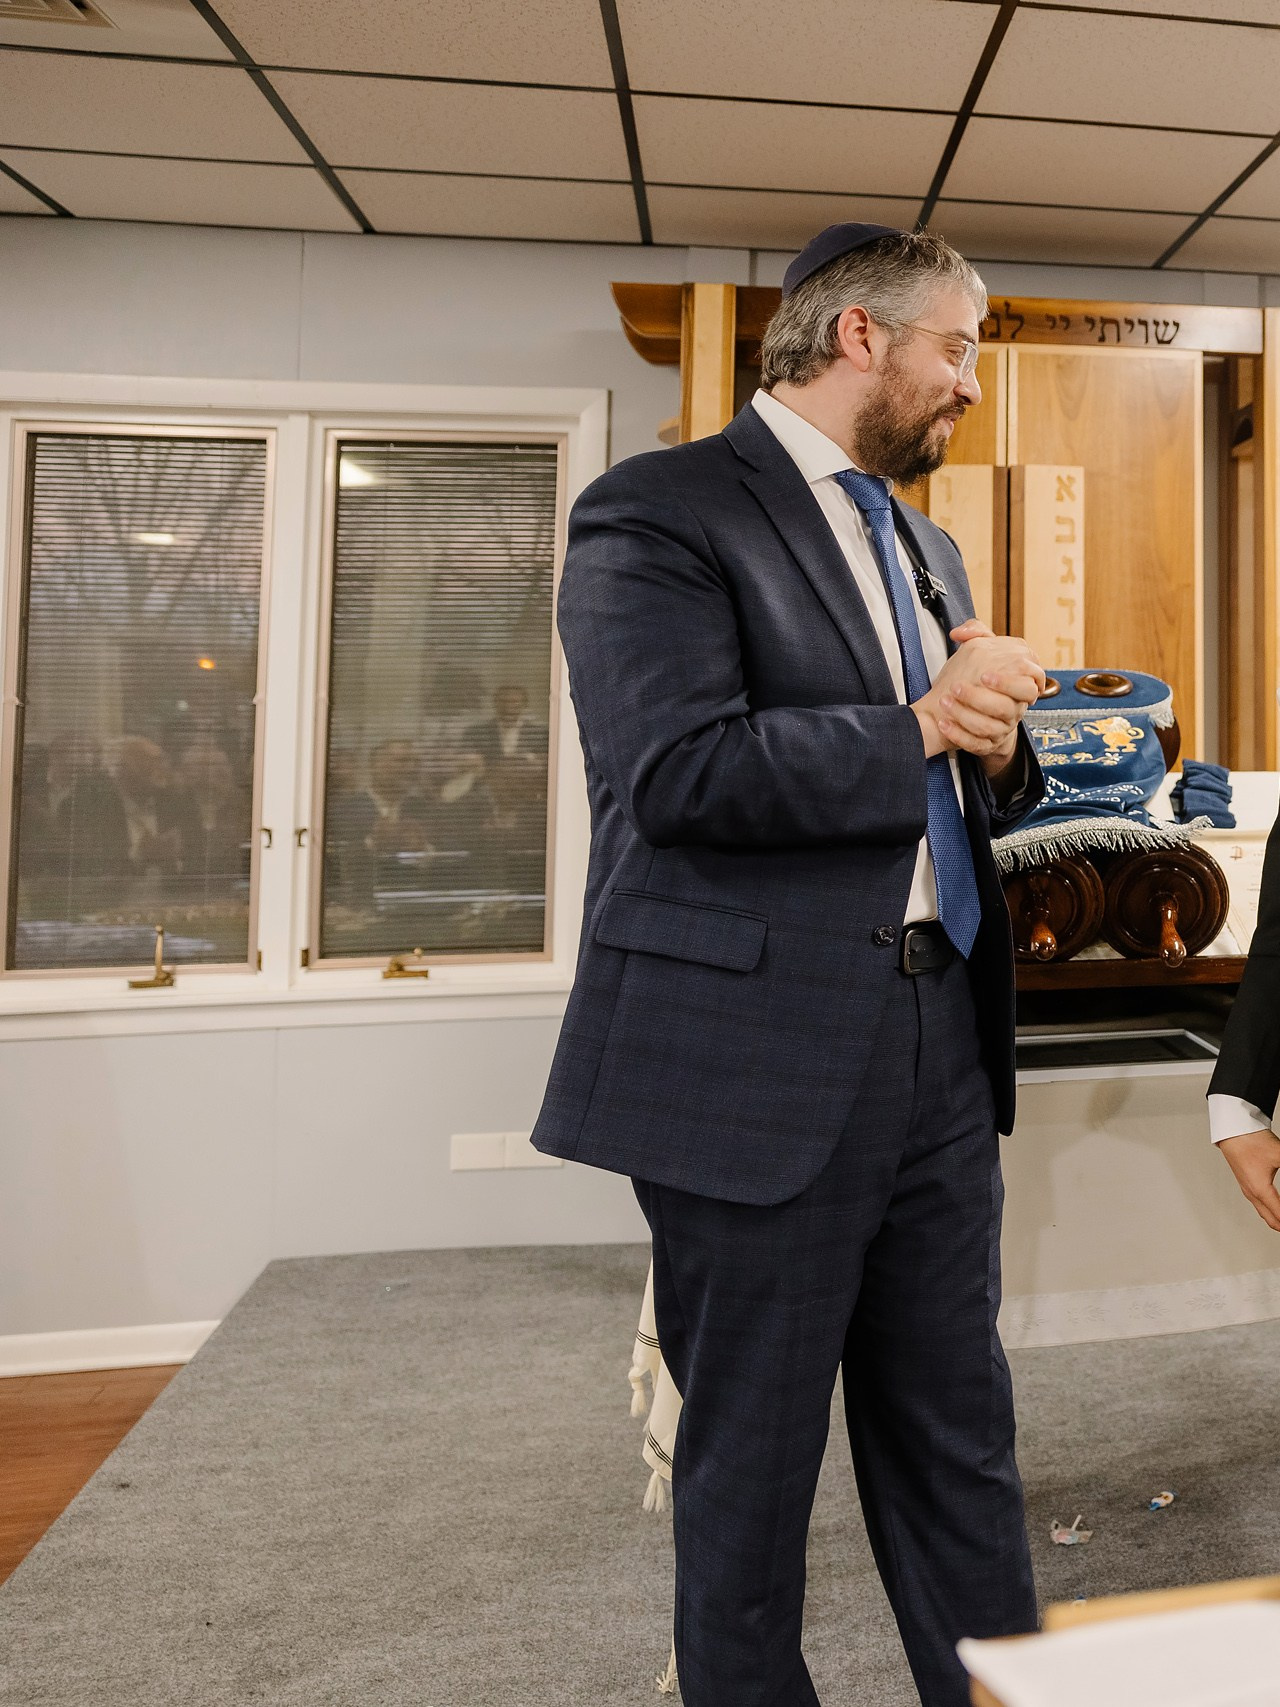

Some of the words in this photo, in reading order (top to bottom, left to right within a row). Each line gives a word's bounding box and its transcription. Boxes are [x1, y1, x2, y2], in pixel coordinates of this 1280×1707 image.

[1045, 313, 1071, 331] יי
[1084, 315, 1180, 345] שויתי
[1055, 474, 1077, 503] א
